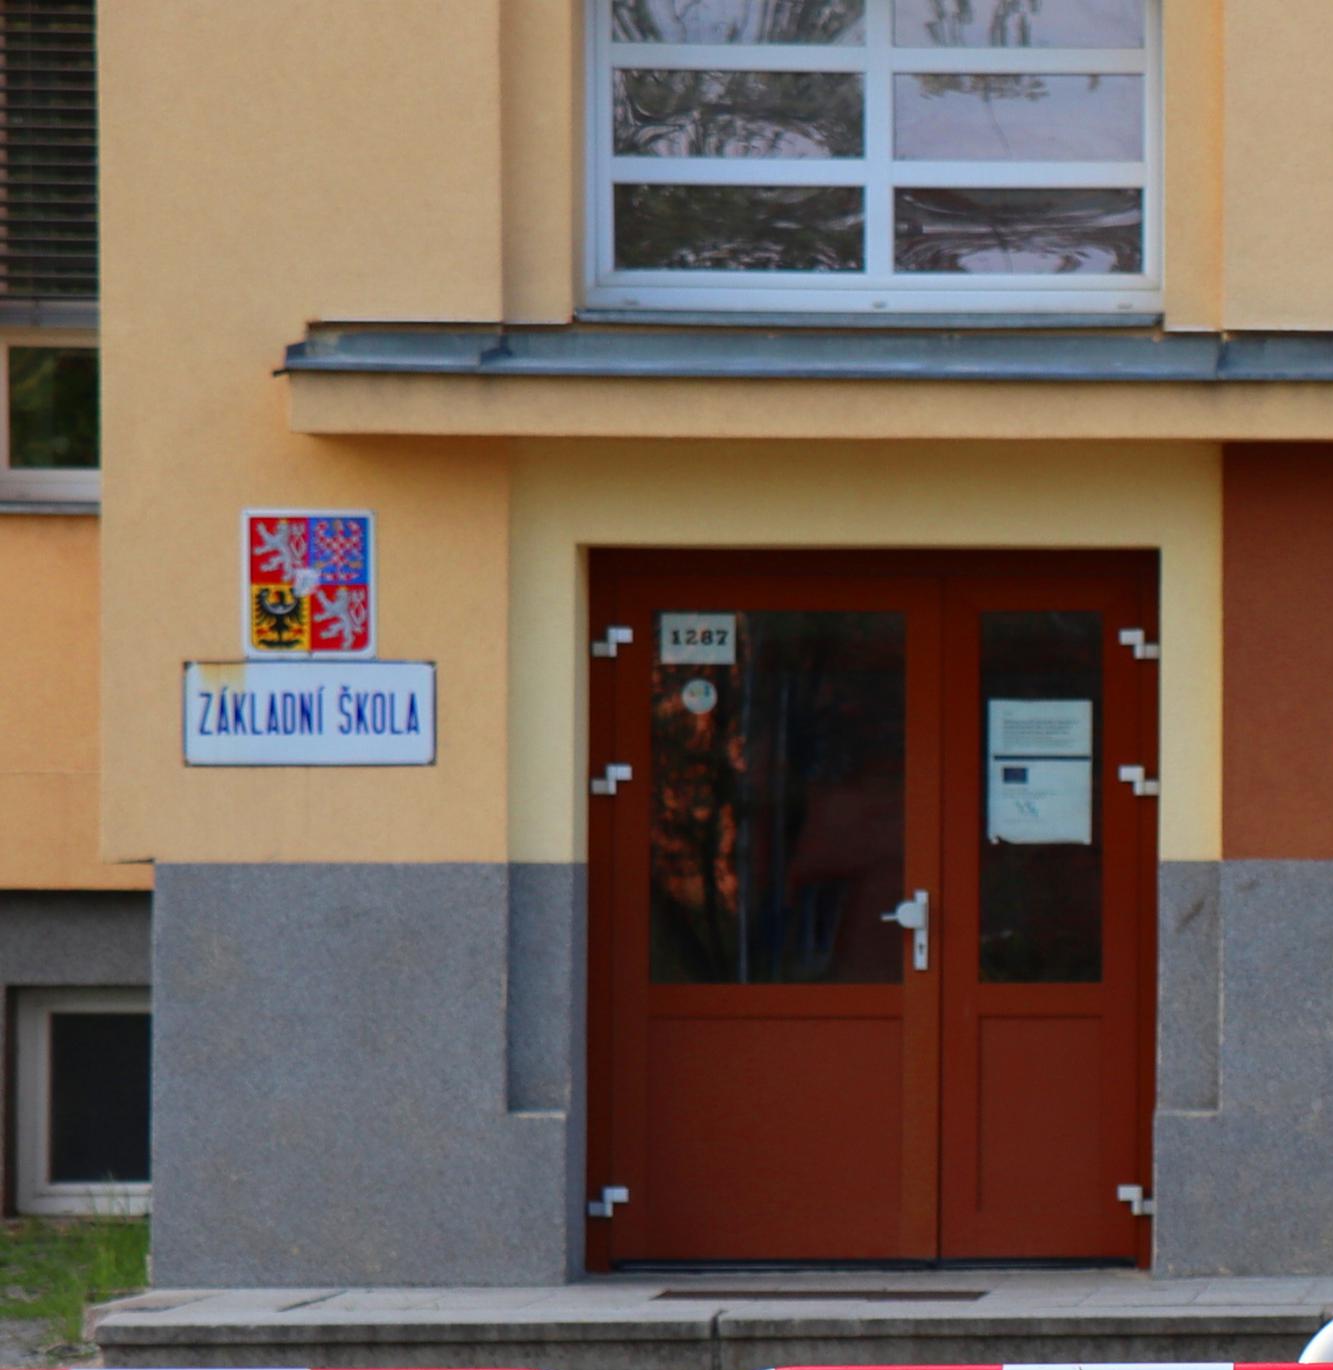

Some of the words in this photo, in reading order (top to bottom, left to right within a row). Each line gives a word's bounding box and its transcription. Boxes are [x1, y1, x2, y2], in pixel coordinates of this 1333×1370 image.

[671, 629, 729, 646] 1287
[198, 686, 325, 736] ZÁKLADNÍ
[338, 686, 420, 736] ŠKOLA
